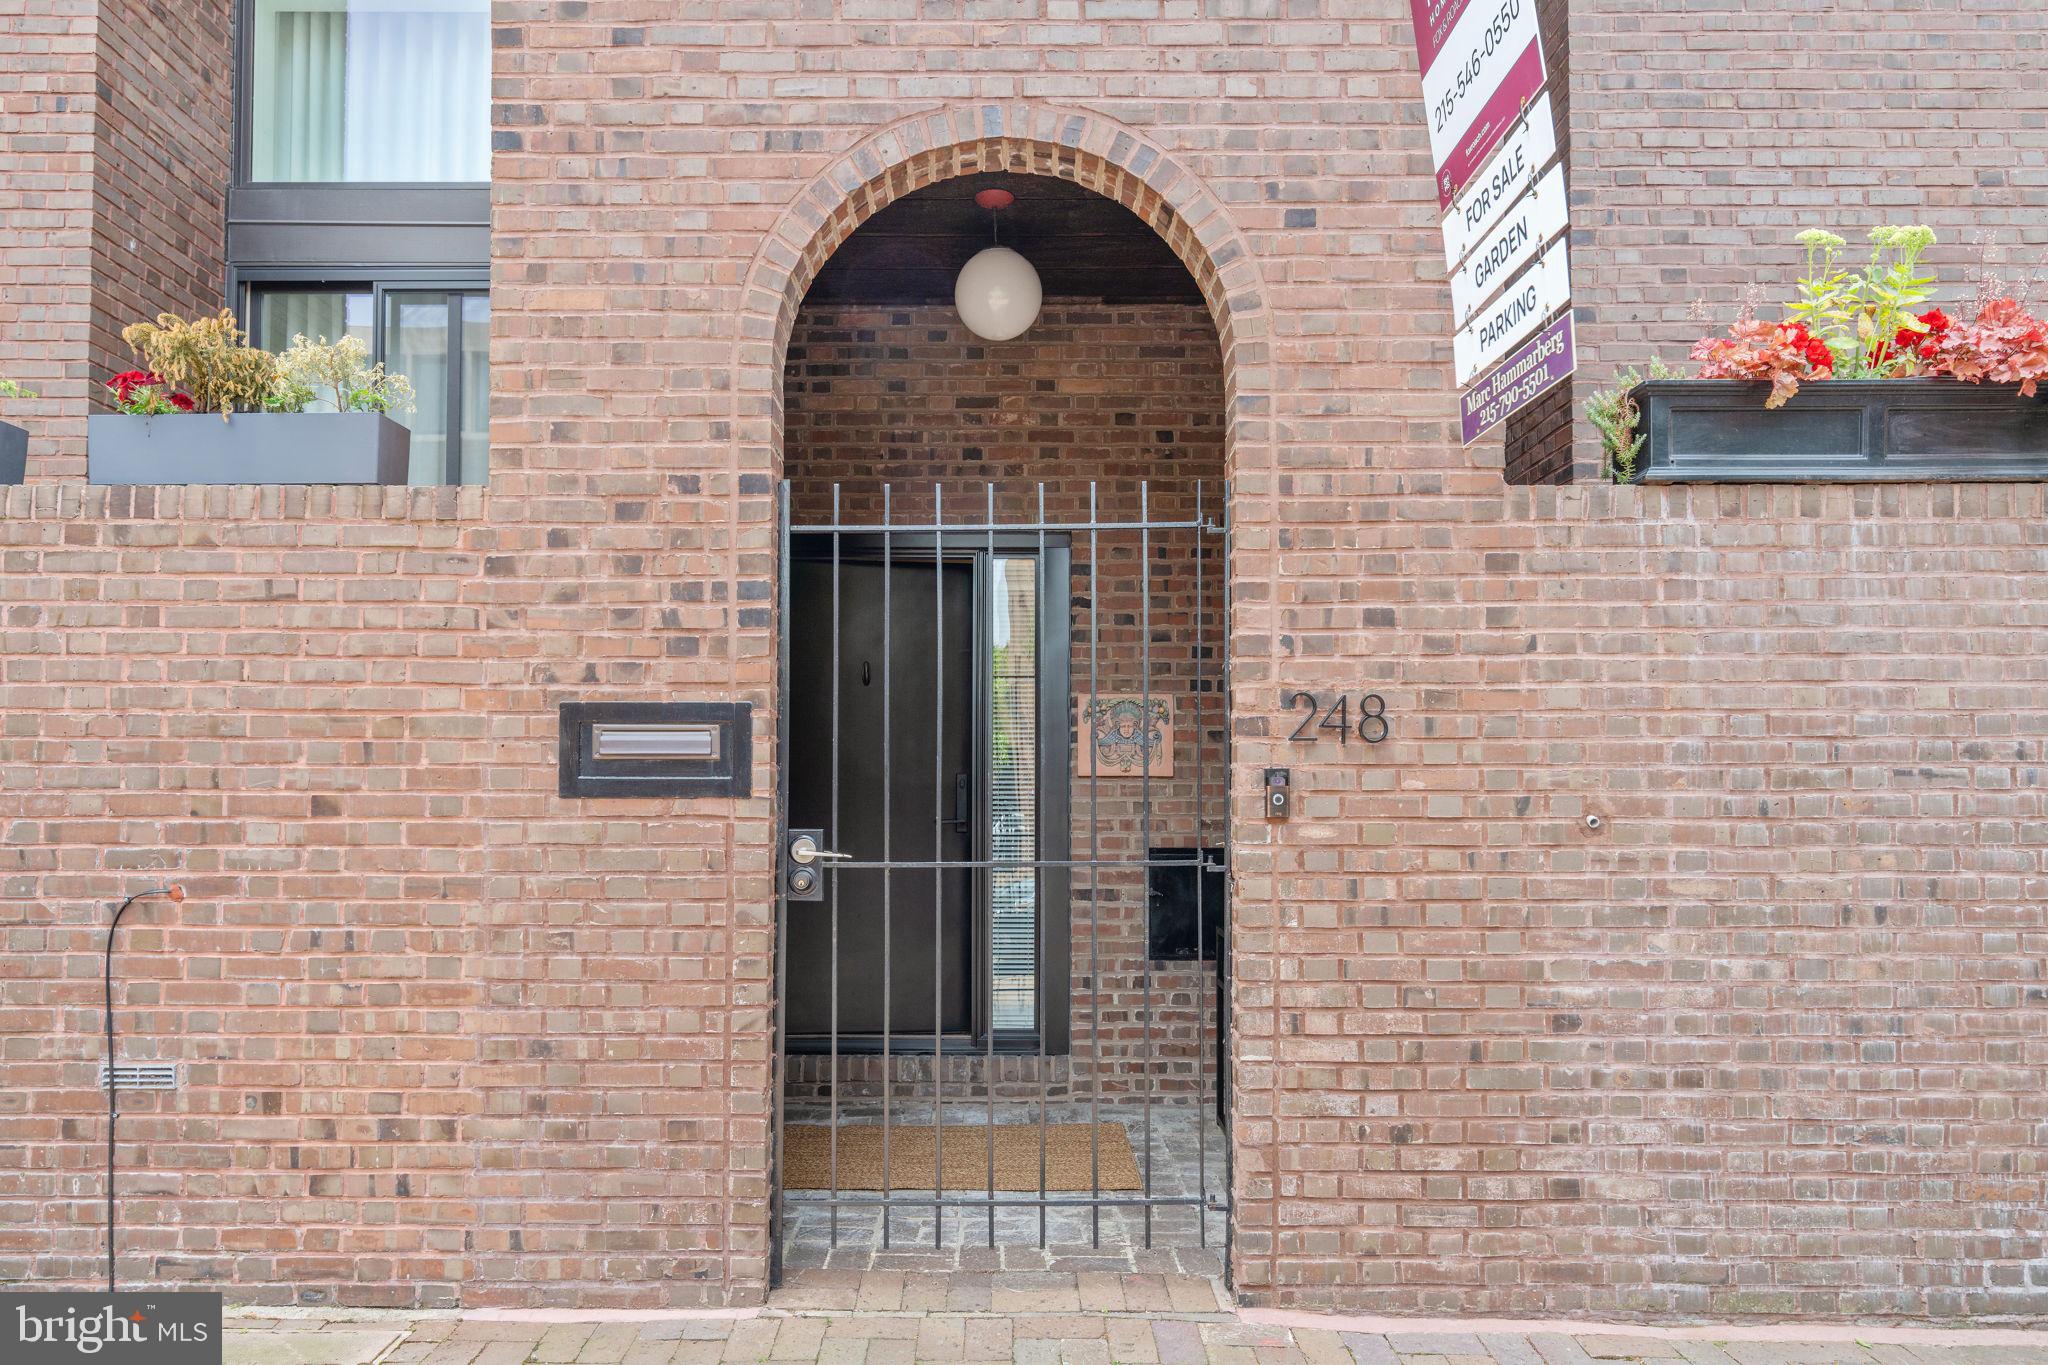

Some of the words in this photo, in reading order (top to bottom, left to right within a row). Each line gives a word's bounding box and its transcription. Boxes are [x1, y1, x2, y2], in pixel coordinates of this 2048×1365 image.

[1433, 27, 1444, 48] FOX
[1442, 18, 1448, 32] &
[1447, 0, 1463, 26] ROA
[1434, 0, 1520, 133] 215-546-0550
[1465, 187, 1491, 232] FOR
[1492, 143, 1525, 201] SALE
[1475, 216, 1529, 288] GARDEN
[1479, 285, 1537, 352] PARKING
[1466, 386, 1491, 416] Marc
[1491, 330, 1565, 397] Hammarberg
[1480, 363, 1549, 426] 215-790-5501
[1288, 692, 1389, 744] 248
